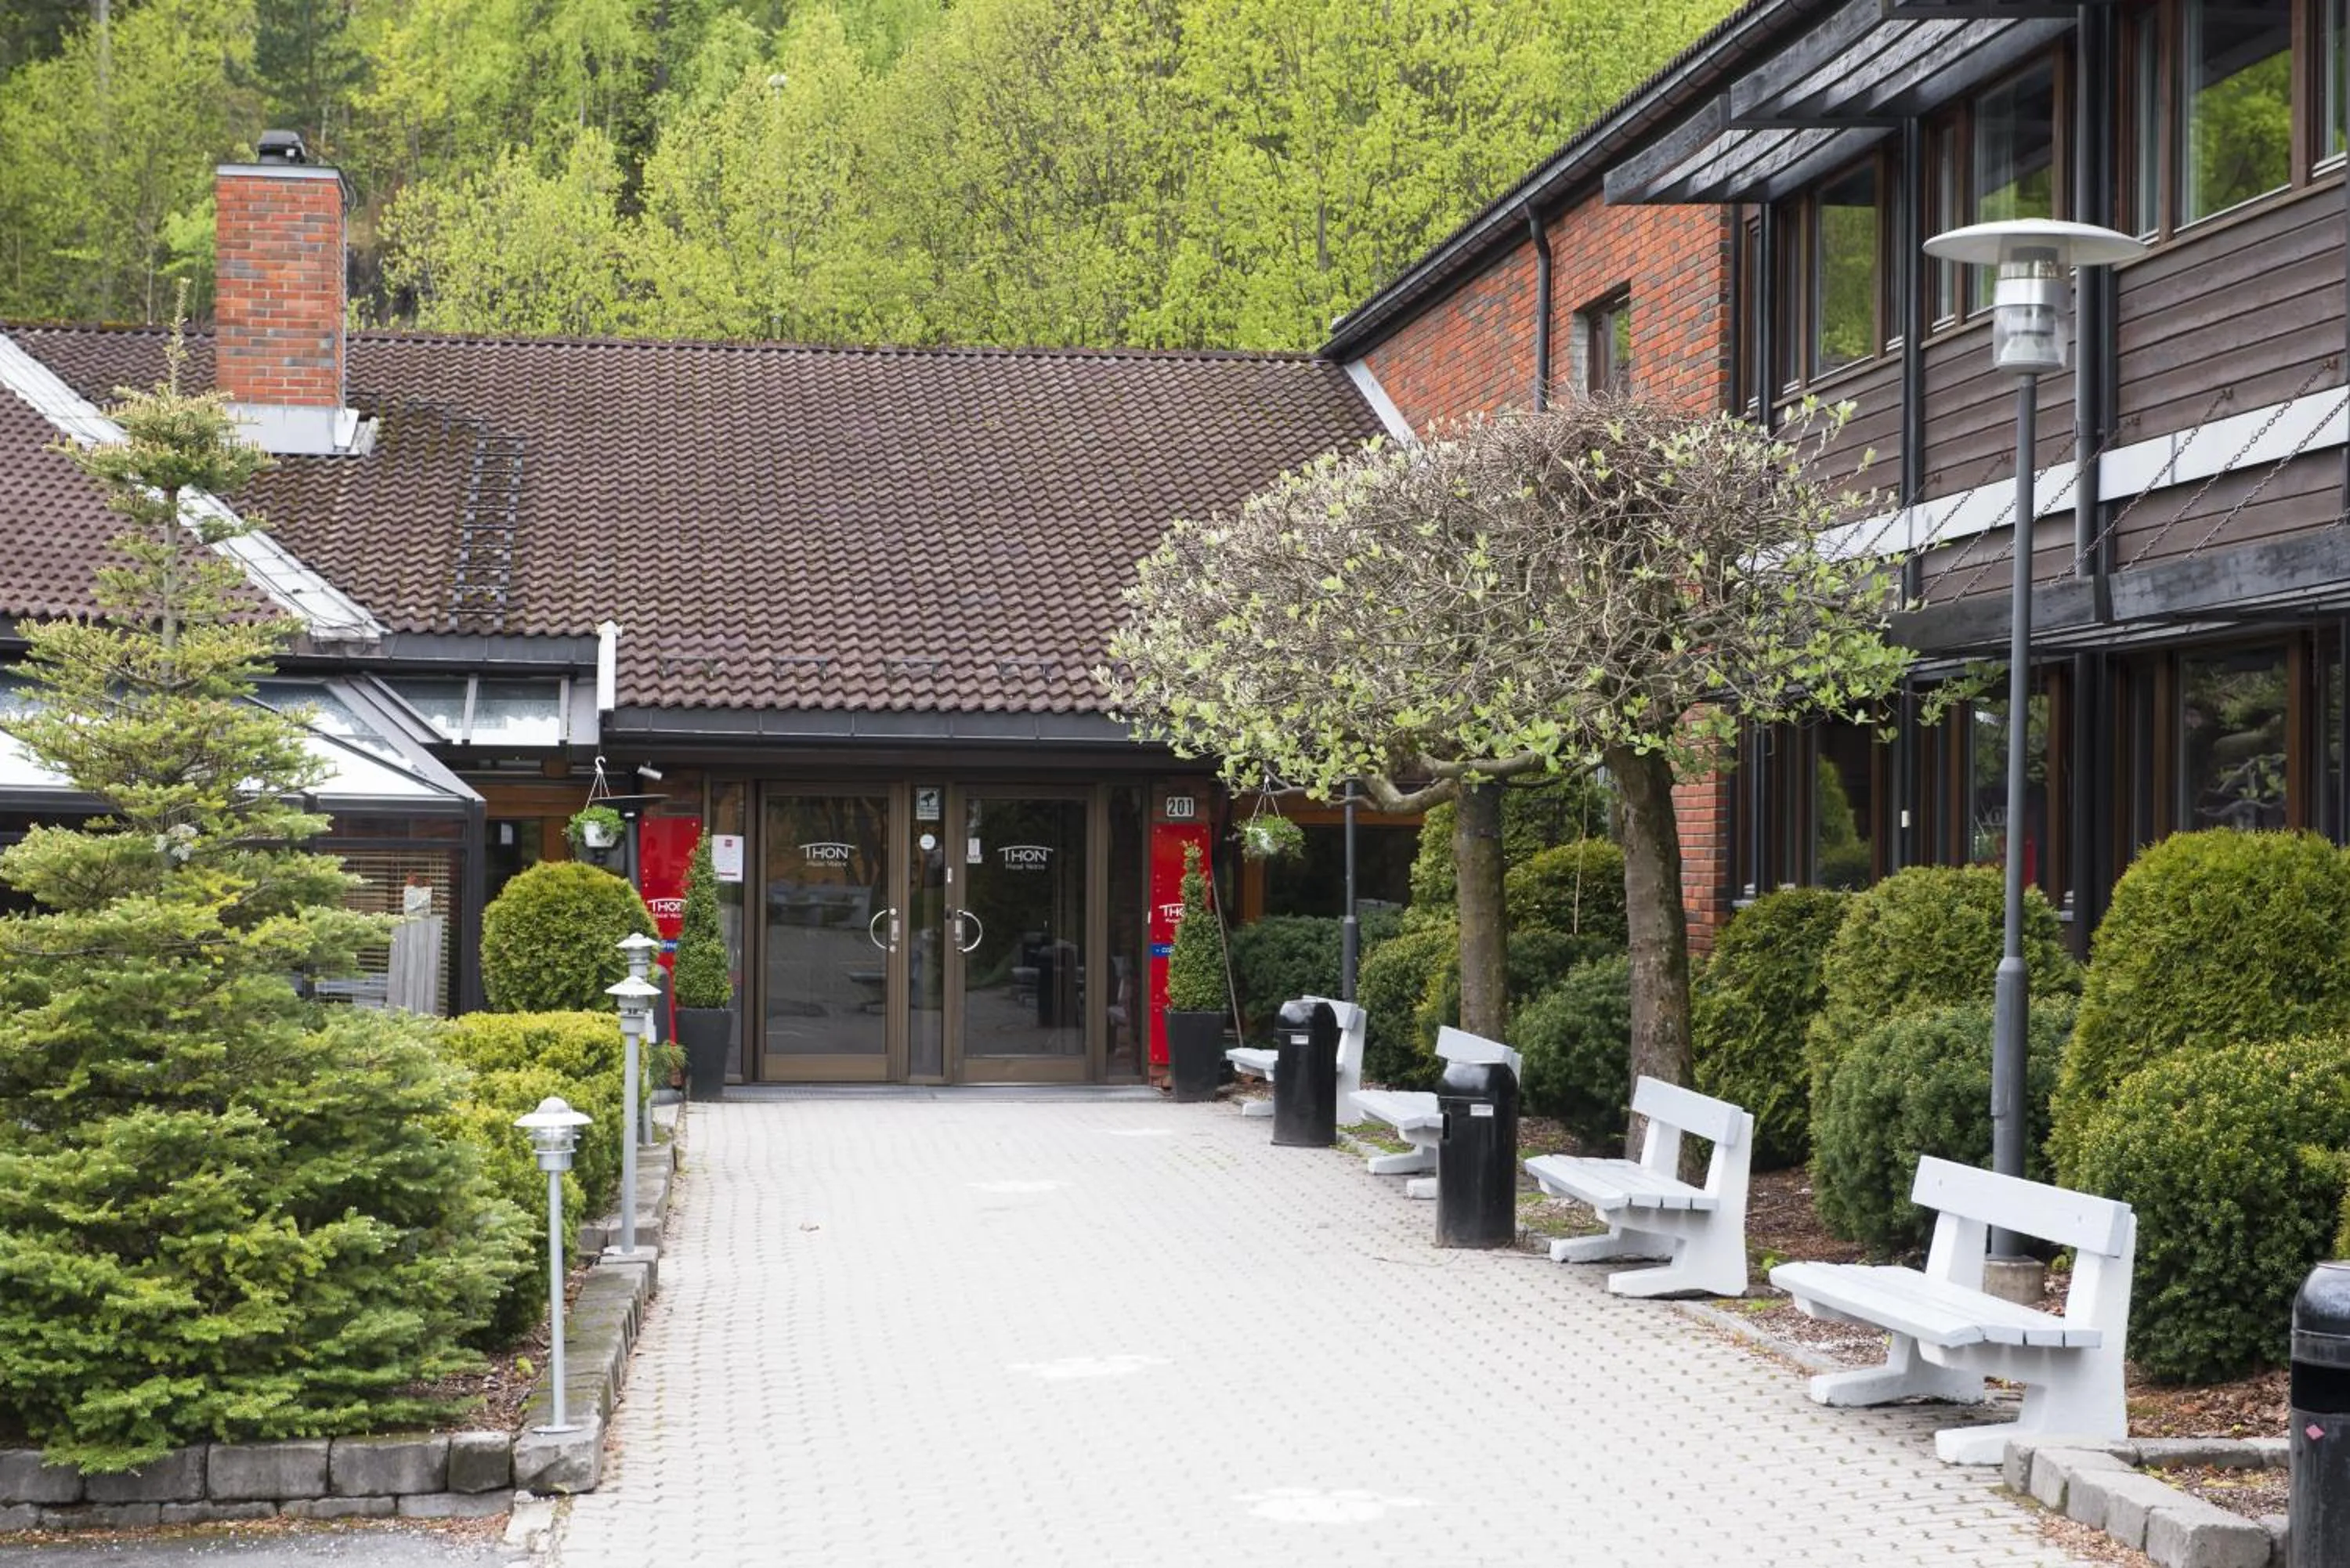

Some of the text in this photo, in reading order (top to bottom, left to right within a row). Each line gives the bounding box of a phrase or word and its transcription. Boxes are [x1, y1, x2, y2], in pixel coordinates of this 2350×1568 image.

[1168, 799, 1191, 815] 201
[800, 843, 855, 859] THON
[997, 845, 1054, 862] THON
